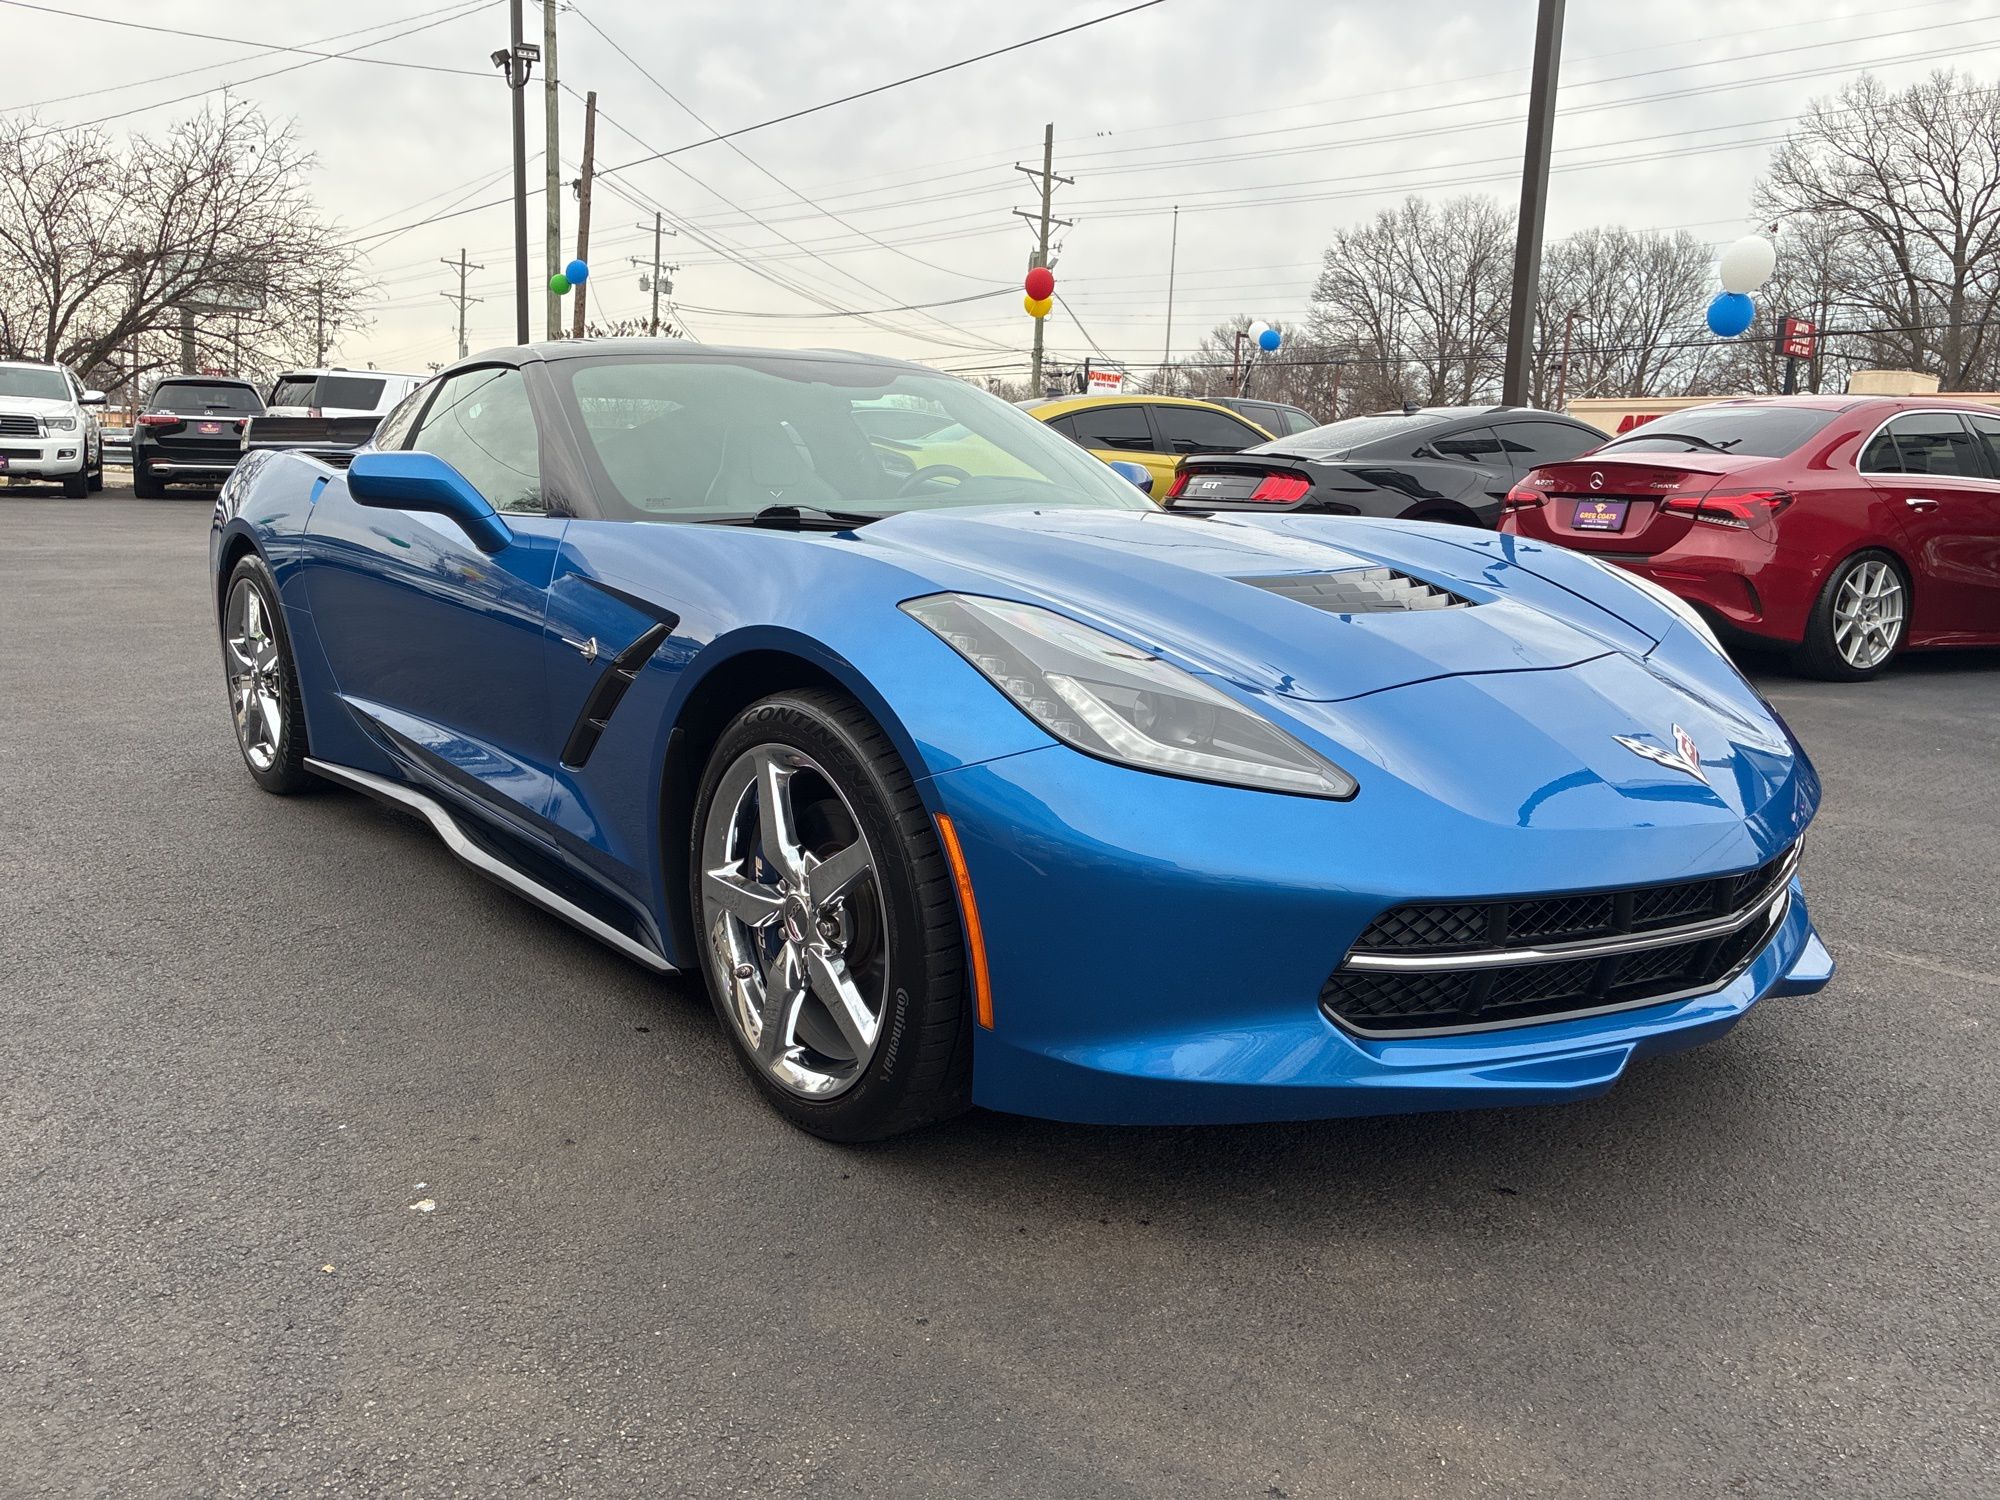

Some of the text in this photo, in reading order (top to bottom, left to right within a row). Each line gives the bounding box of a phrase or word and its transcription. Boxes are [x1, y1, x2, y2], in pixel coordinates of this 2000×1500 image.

[1202, 481, 1222, 489] GT
[1597, 512, 1617, 520] COATS
[883, 987, 909, 1076] Continental
